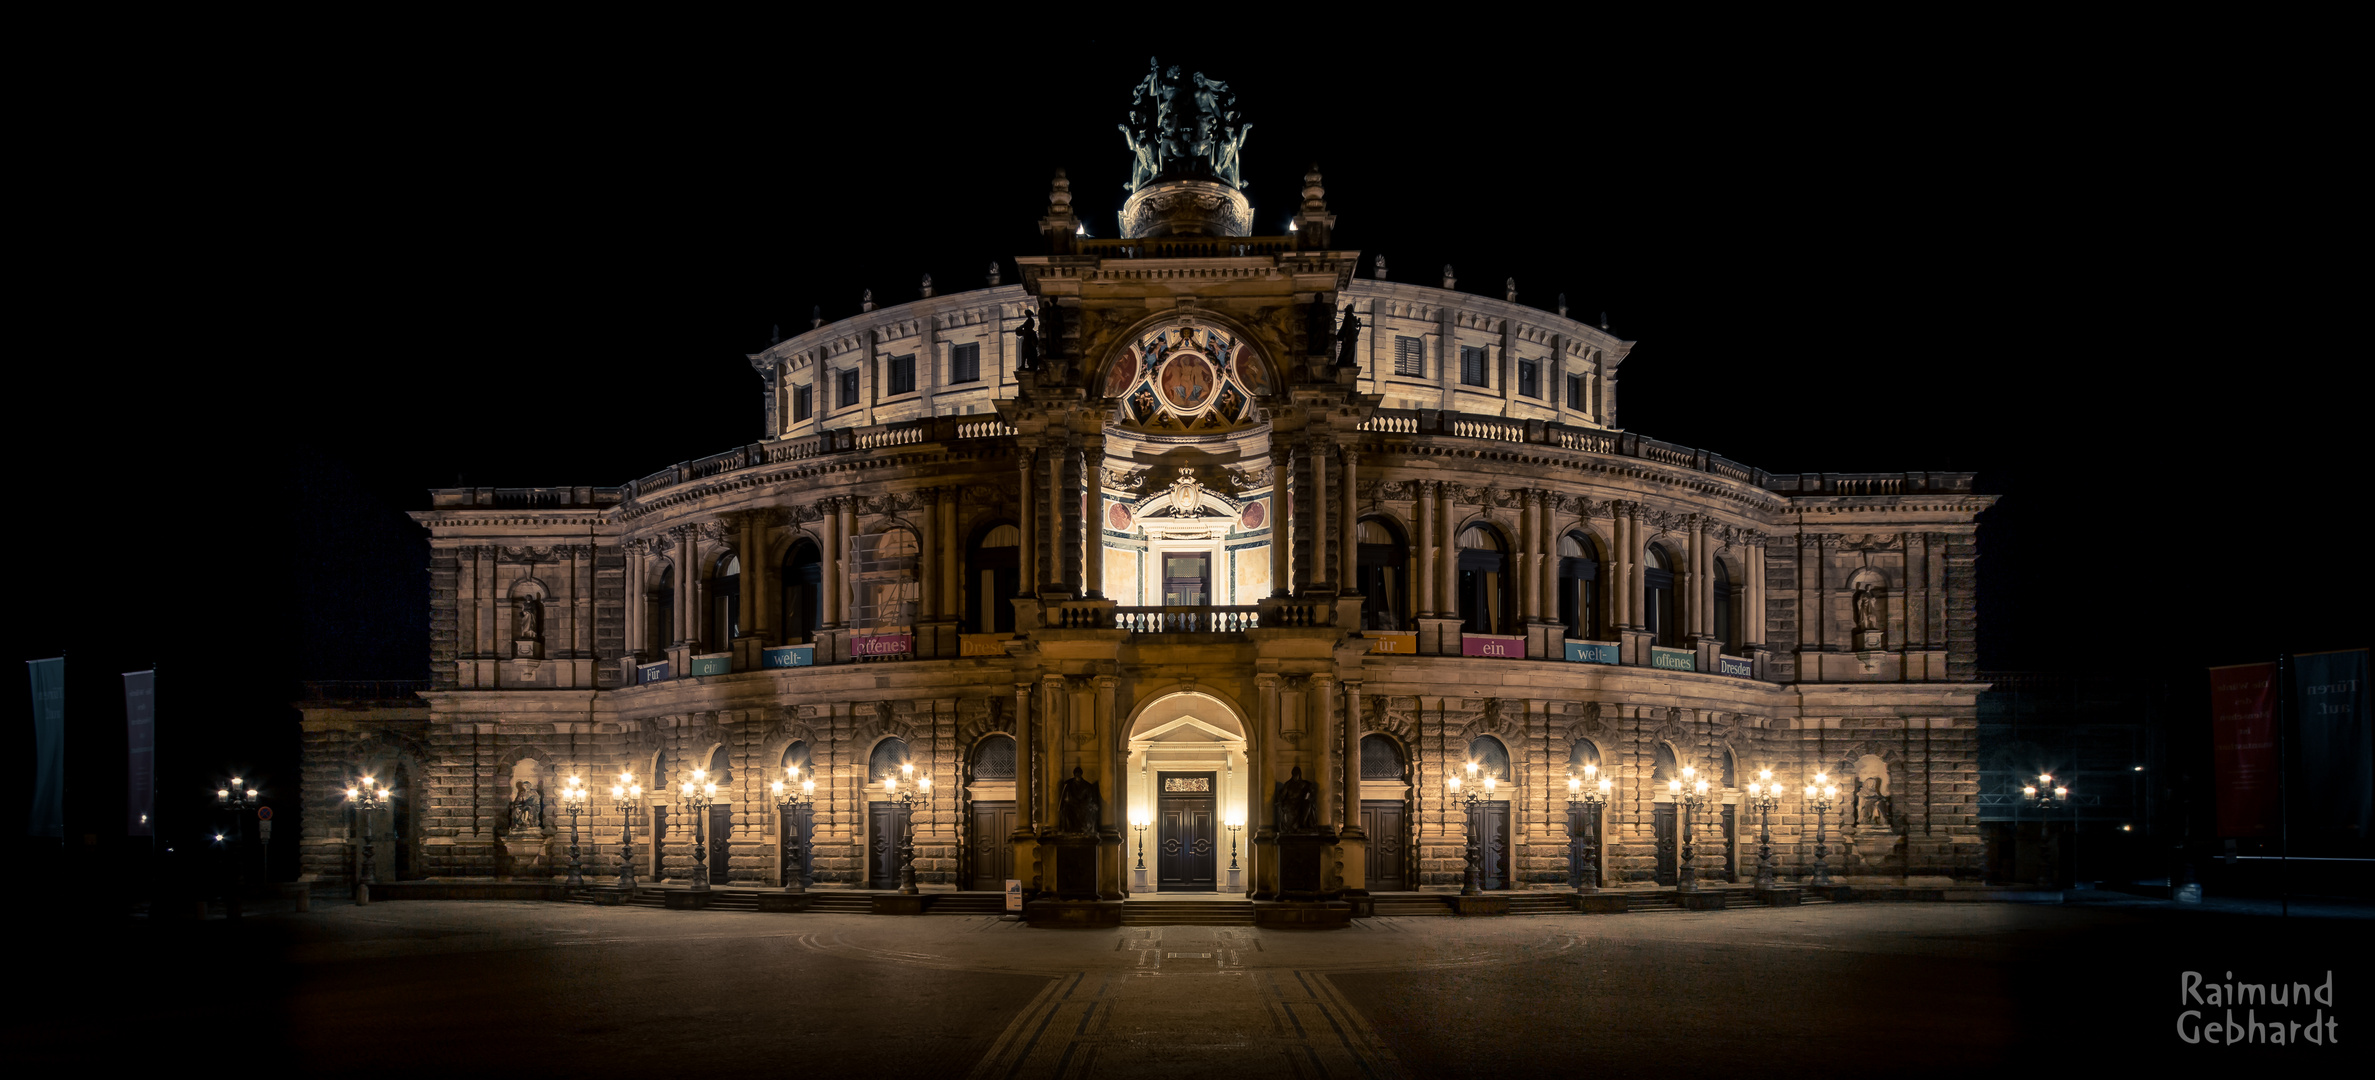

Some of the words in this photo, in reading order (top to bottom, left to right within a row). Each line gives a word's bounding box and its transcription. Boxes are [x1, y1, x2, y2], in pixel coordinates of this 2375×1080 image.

[856, 638, 906, 654] offenes
[1482, 640, 1506, 655] ein
[774, 651, 801, 666] welt-
[1577, 647, 1607, 661] welt-
[1655, 653, 1692, 669] offenes
[647, 667, 660, 681] Für
[704, 660, 718, 673] ein
[1721, 660, 1752, 676] Dresden
